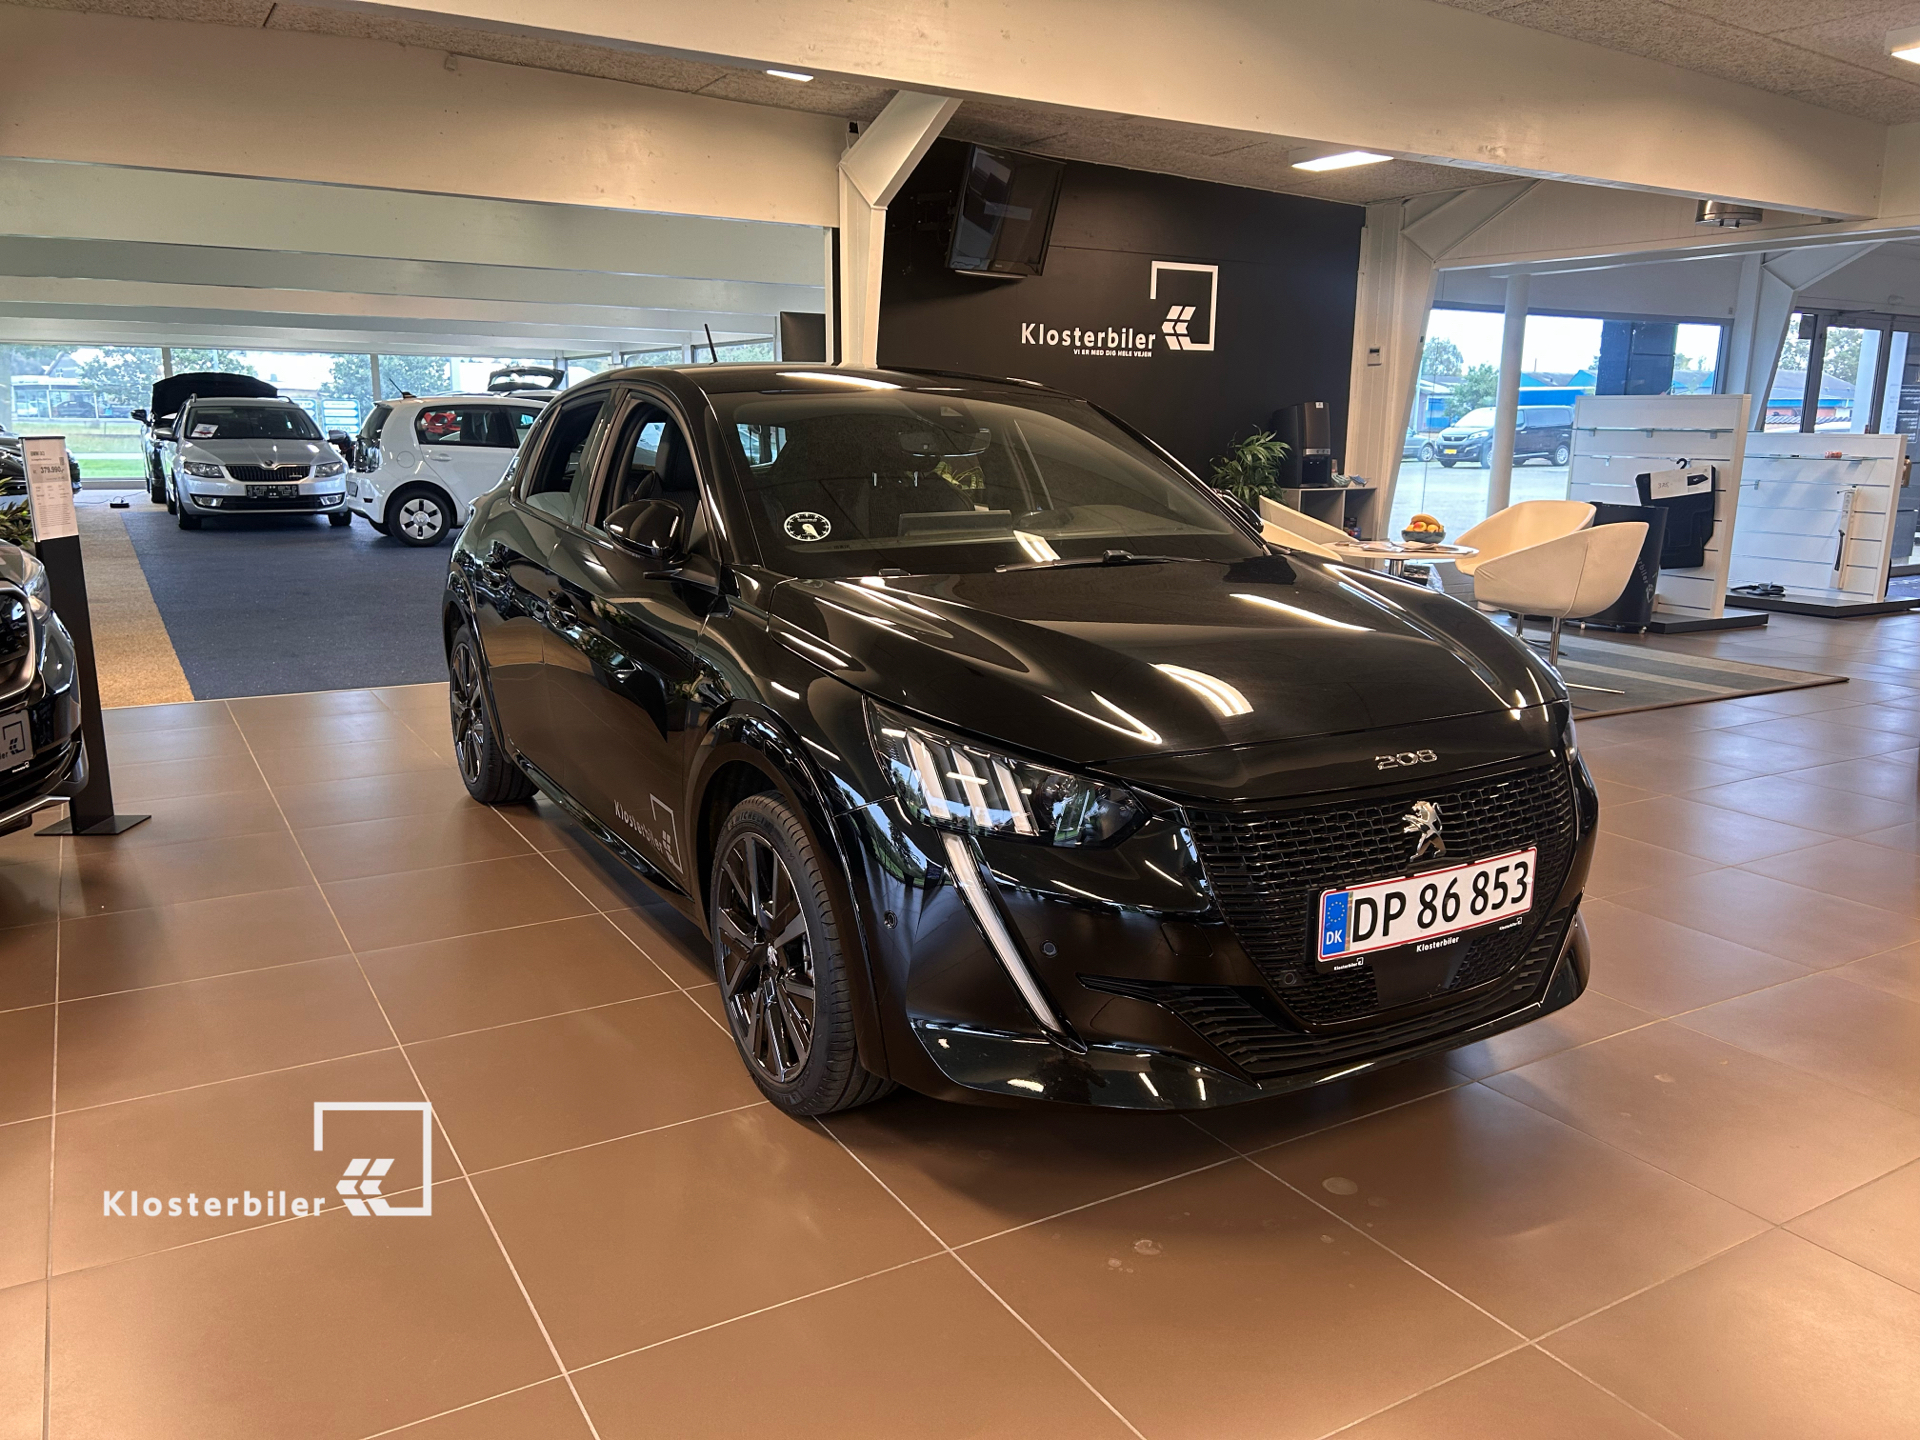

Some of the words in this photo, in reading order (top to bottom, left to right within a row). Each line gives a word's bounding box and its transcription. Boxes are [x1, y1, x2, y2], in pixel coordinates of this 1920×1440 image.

[1021, 322, 1156, 350] Klosterbiler
[1374, 749, 1438, 771] 208
[613, 799, 664, 854] Klosterbiler
[1351, 890, 1407, 943] DP
[1417, 876, 1461, 930] 86
[1470, 861, 1529, 916] 853
[1325, 929, 1343, 946] DK
[1416, 935, 1460, 953] Klosterbiler
